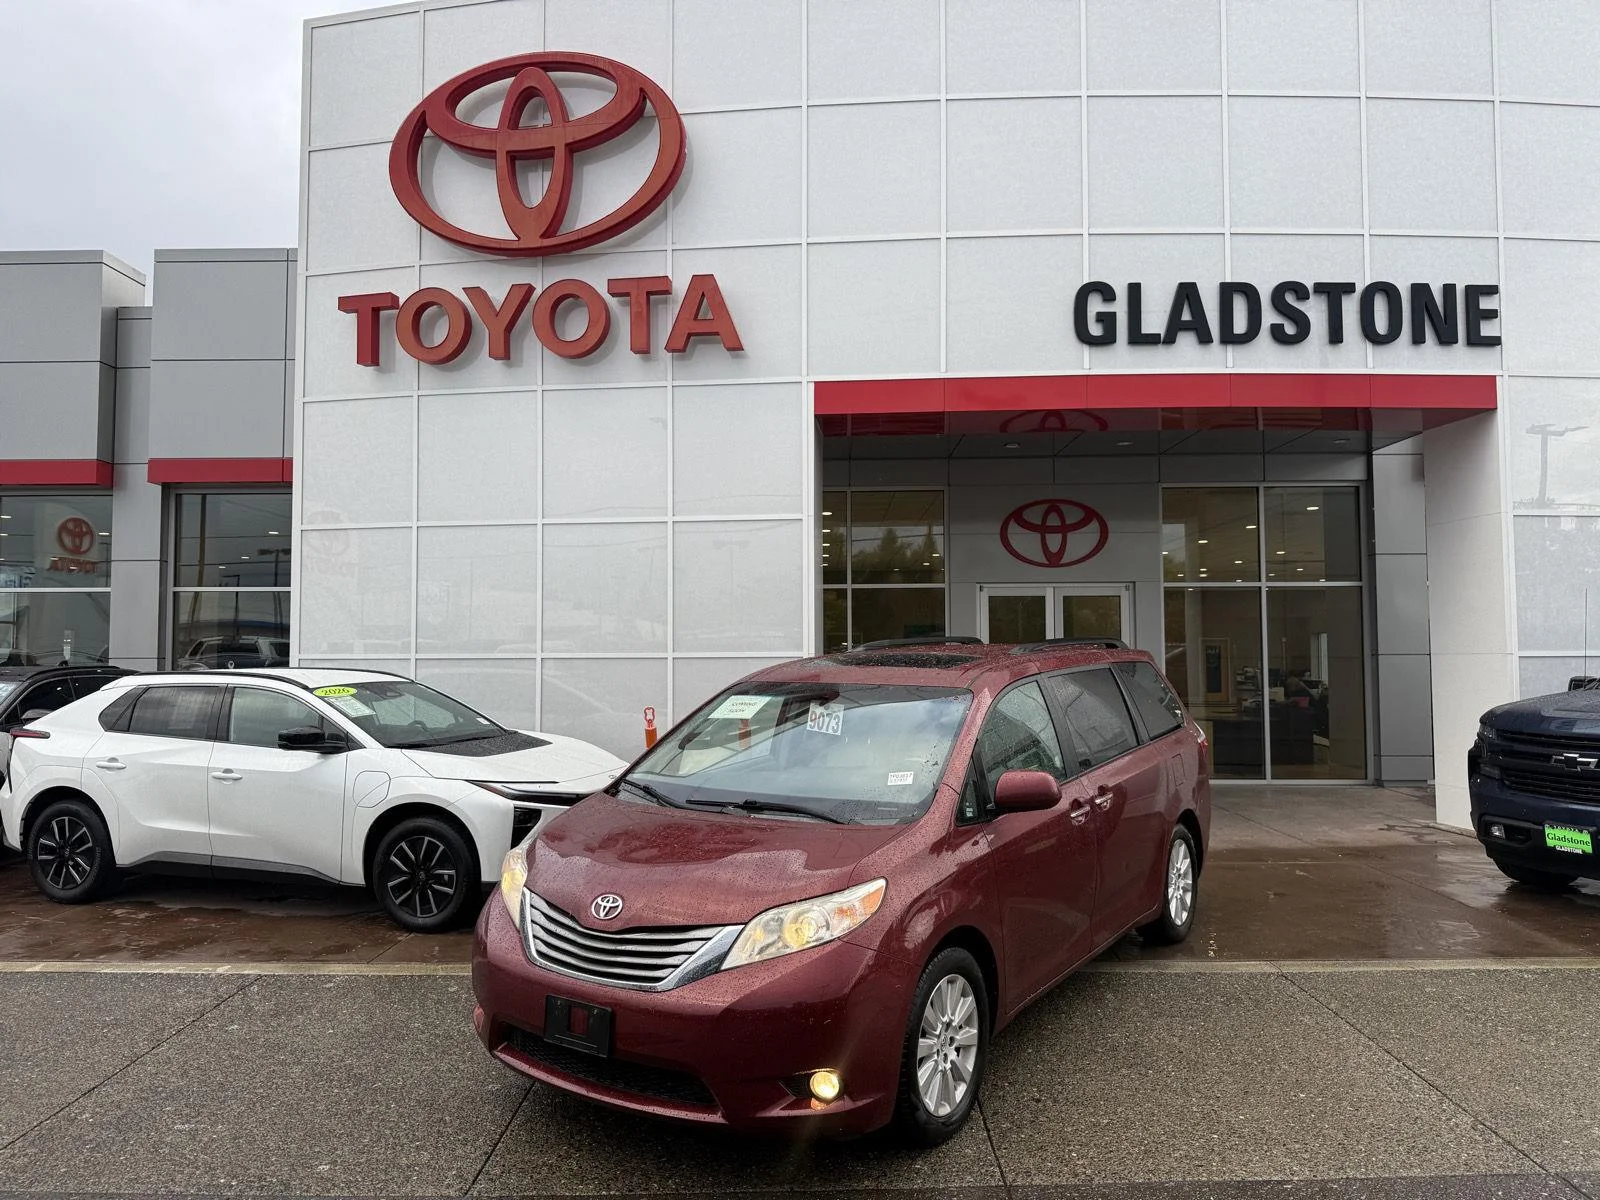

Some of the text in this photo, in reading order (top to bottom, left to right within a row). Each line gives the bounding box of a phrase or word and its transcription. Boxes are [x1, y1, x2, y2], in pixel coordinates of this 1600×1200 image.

[338, 274, 744, 367] TOYOTA
[1074, 281, 1502, 346] GLADSTONE
[321, 687, 350, 695] 2026
[808, 710, 841, 734] 9073
[1546, 832, 1591, 847] Gladstone
[1555, 845, 1583, 854] GLADSTONE
